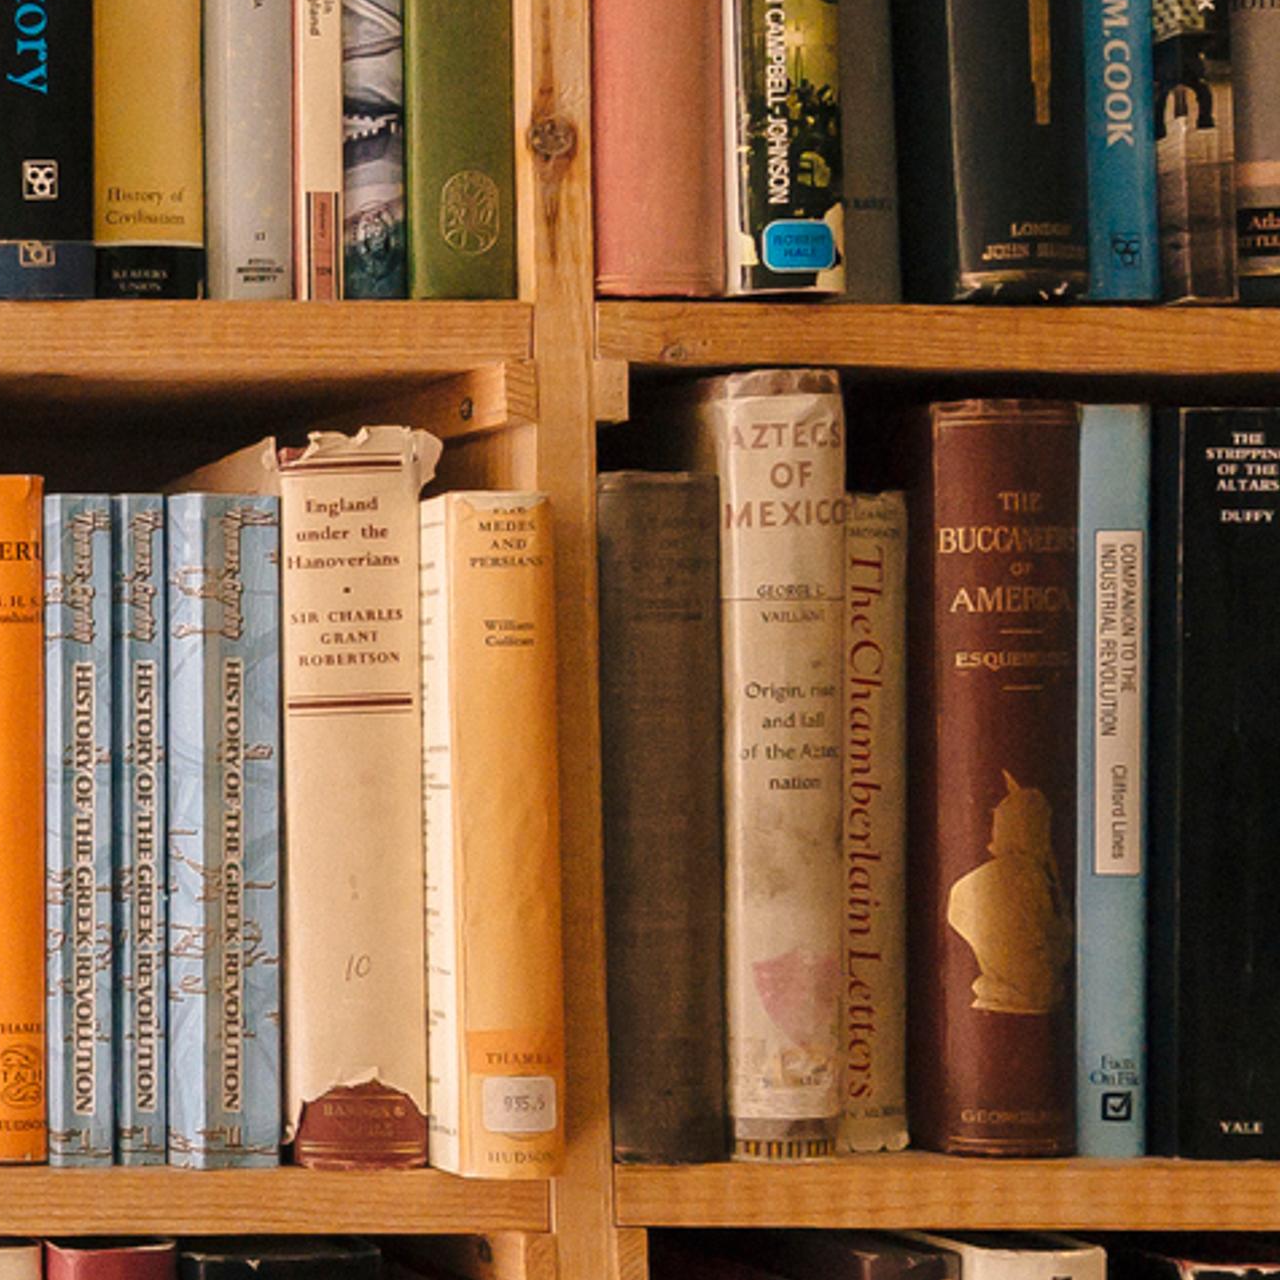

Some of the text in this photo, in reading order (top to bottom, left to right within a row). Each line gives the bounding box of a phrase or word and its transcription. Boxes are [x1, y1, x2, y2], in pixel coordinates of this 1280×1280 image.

[305, 497, 378, 516] England
[296, 524, 388, 543] under the
[287, 551, 400, 570] Hanoverians
[289, 609, 403, 625] SIR CHARLES
[320, 631, 378, 645] GRANT
[299, 652, 400, 666] ROBERTSON
[1110, 764, 1129, 859] Clifford Lines
[1220, 1120, 1263, 1134] YALE
